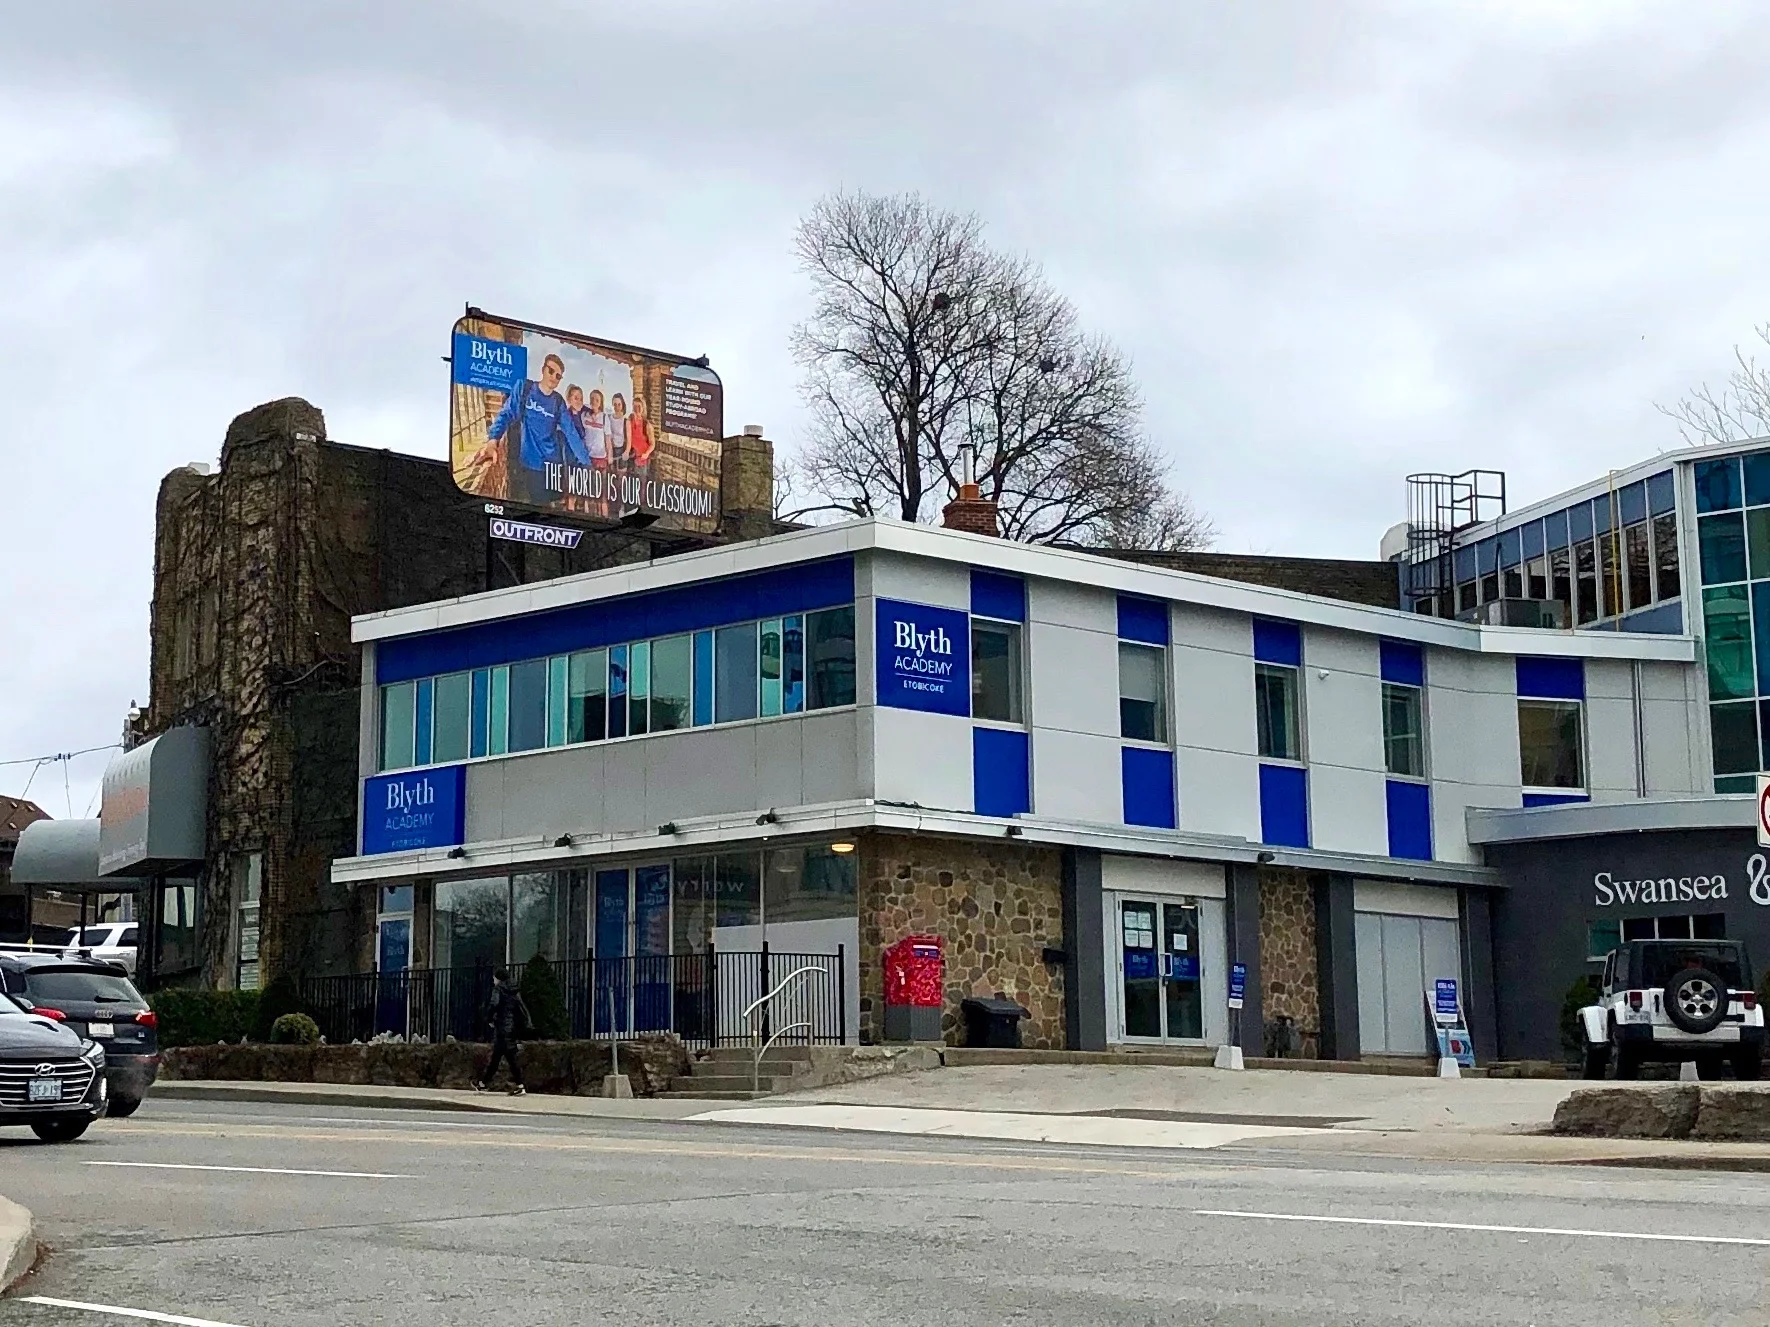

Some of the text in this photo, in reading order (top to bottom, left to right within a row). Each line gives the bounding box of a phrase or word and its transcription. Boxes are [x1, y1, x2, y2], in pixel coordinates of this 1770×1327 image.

[471, 341, 513, 365] Blyth
[470, 362, 513, 378] ACADEMY
[544, 462, 712, 517] THE WORLD IS OUR CLASSROOM!
[484, 503, 504, 515] 6252
[493, 521, 577, 546] OUTFRONT
[893, 620, 952, 657] Blyth
[894, 655, 953, 676] ACADEMY
[903, 680, 945, 693] ETOBICOKE
[386, 778, 434, 813] Blyth
[385, 813, 435, 831] ACADEMY
[1594, 872, 1728, 906] Swansea
